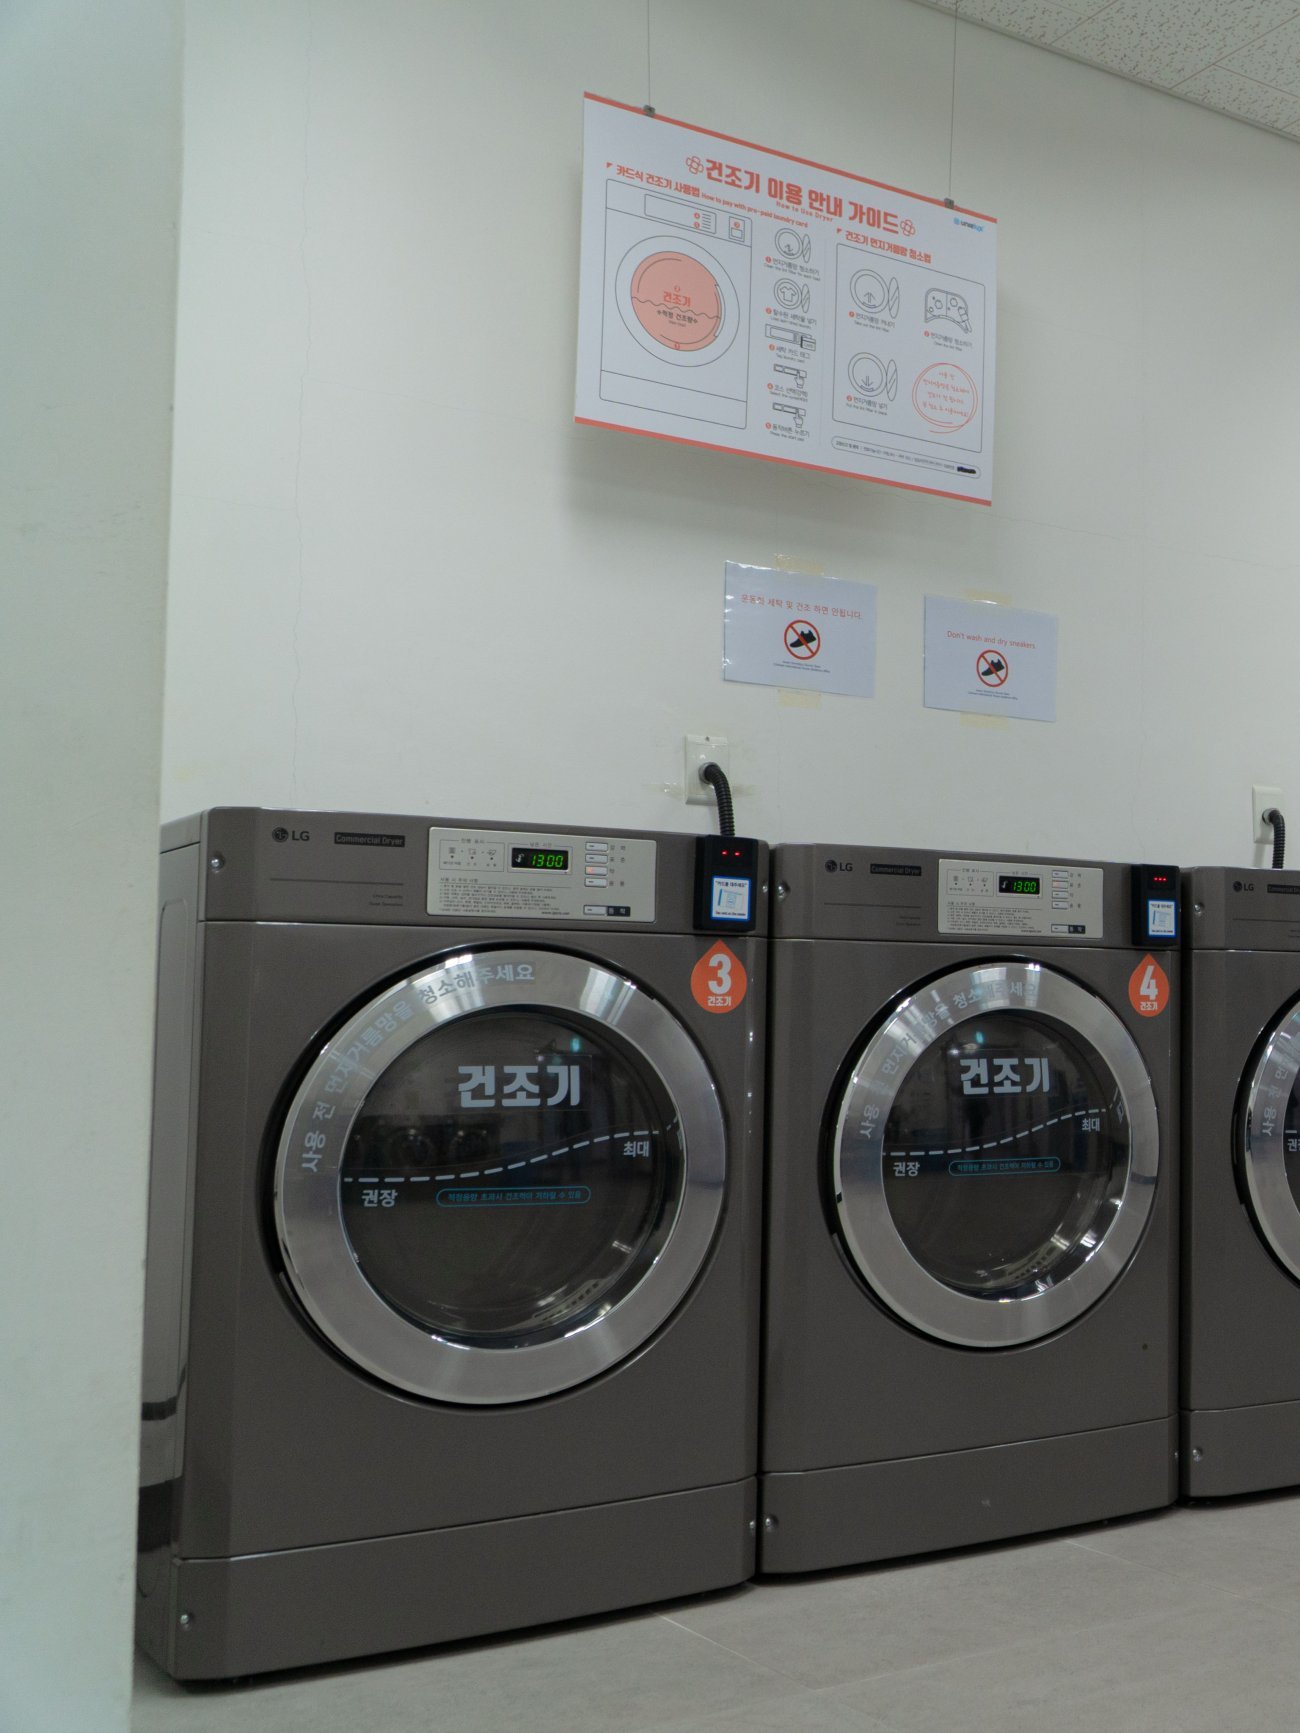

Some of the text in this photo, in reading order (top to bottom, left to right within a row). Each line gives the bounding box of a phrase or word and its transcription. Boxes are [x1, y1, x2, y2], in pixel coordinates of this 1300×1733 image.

[616, 164, 700, 198] 카드식 건조기 사용법
[705, 158, 899, 234] 건조기 이용 안내 가이드
[734, 202, 747, 211] with
[845, 230, 869, 246] 건조기
[663, 290, 691, 307] 건조기
[796, 601, 811, 612] 건조
[813, 604, 829, 615] 하면
[946, 630, 1036, 650] Don't wash and dry sneakers
[291, 829, 311, 842] LG
[335, 833, 403, 847] Commercial Dryer
[839, 861, 854, 873] LG
[1243, 882, 1255, 892] LG
[708, 953, 732, 995] 3
[1139, 965, 1159, 1000] 4
[707, 996, 732, 1007] 건조기
[1140, 1001, 1159, 1011] 건조기
[881, 1003, 951, 1077] 먼지거망을
[959, 1056, 1051, 1096] 건조기
[457, 1064, 582, 1109] 건조기
[1081, 1117, 1101, 1132] 최대
[301, 1131, 326, 1172] 사용
[622, 1141, 651, 1158] 최대
[892, 1160, 921, 1177] 권장
[361, 1189, 399, 1208] 권장
